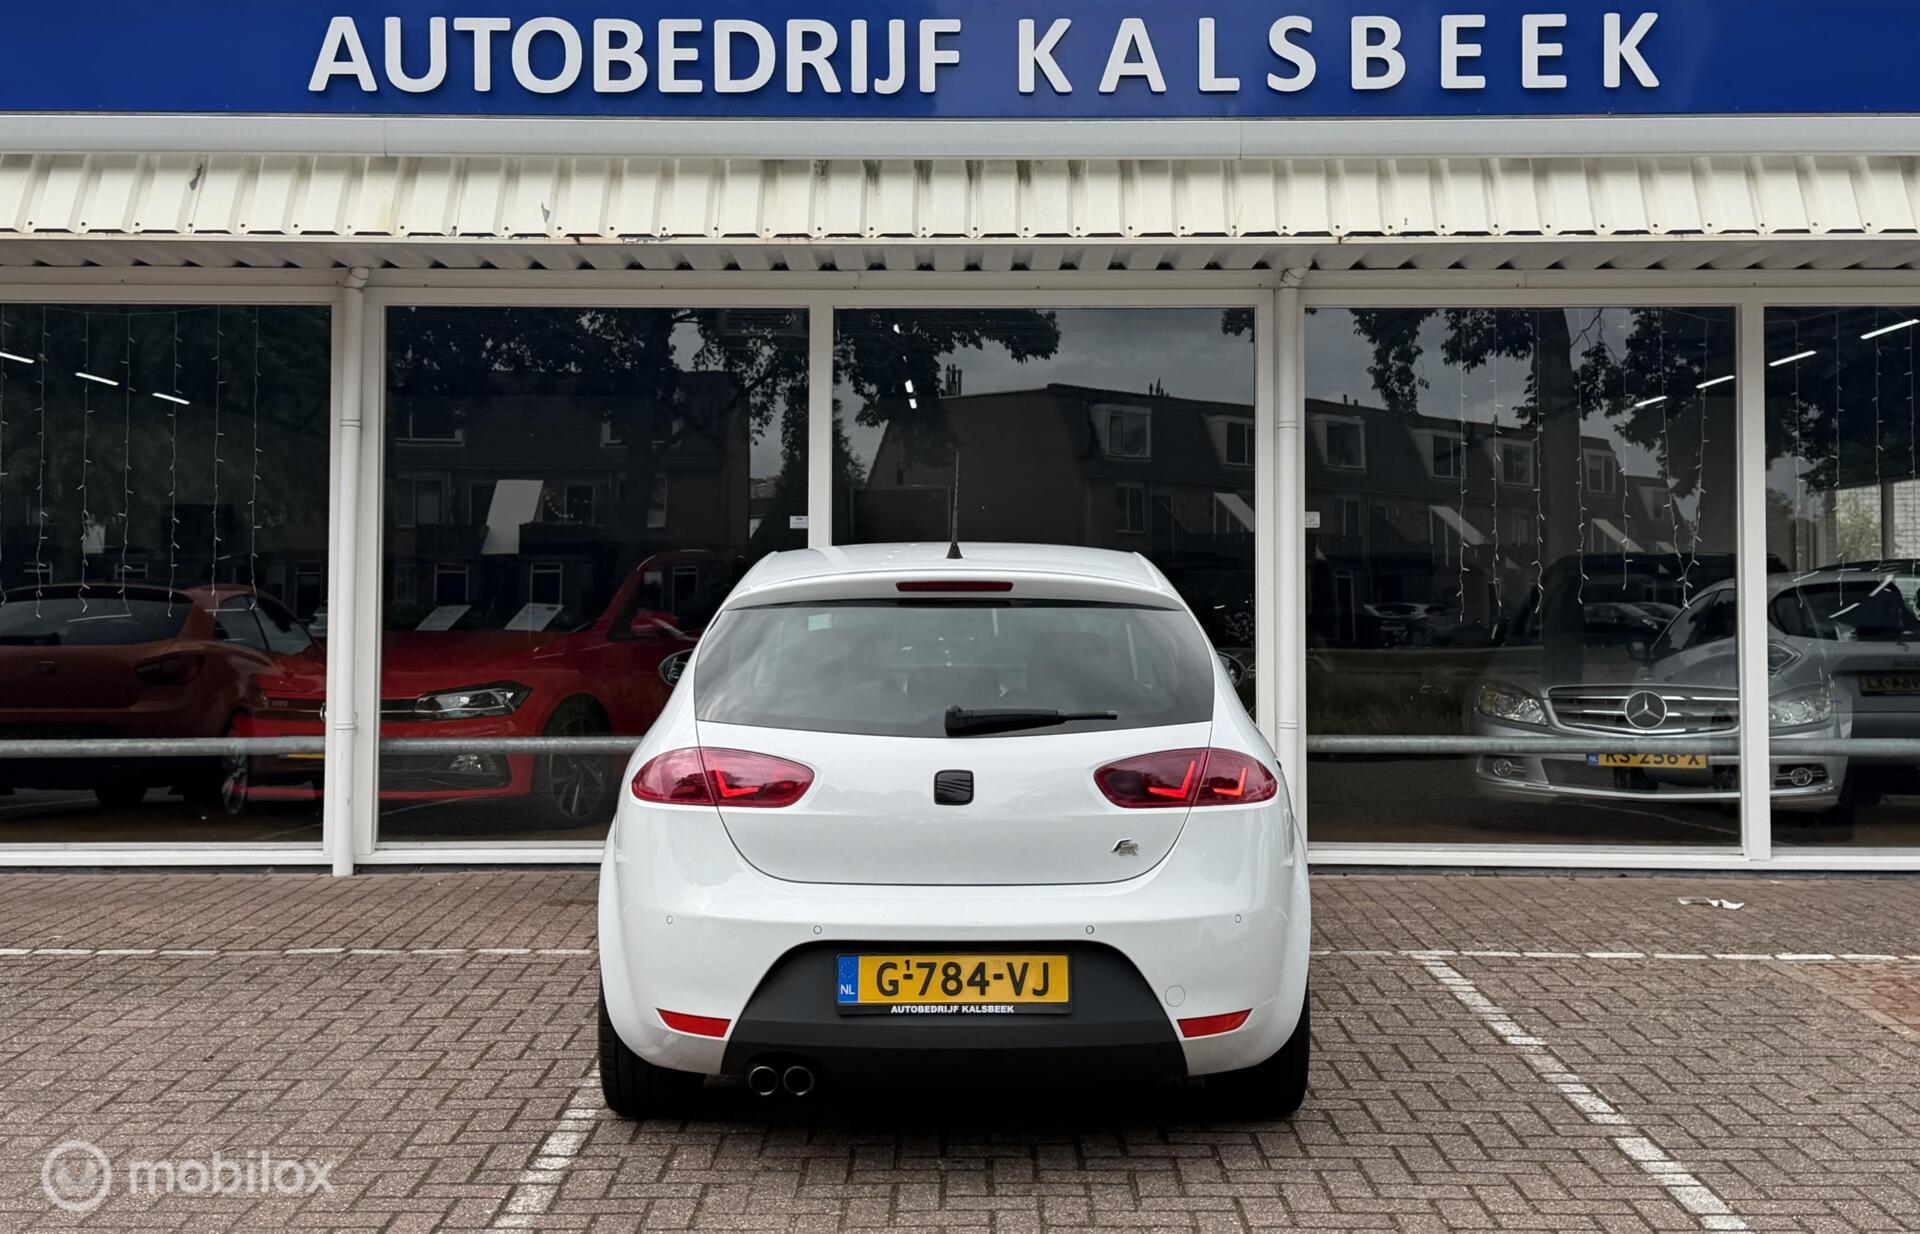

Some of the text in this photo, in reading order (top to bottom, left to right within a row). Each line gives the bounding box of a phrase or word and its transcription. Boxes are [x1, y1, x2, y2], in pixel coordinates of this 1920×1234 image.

[308, 12, 1660, 94] AUTOBEDRIJF KALSBEEK
[840, 984, 855, 995] NL
[891, 1005, 1015, 1014] AUTOBEDRIJF KALSBEEK
